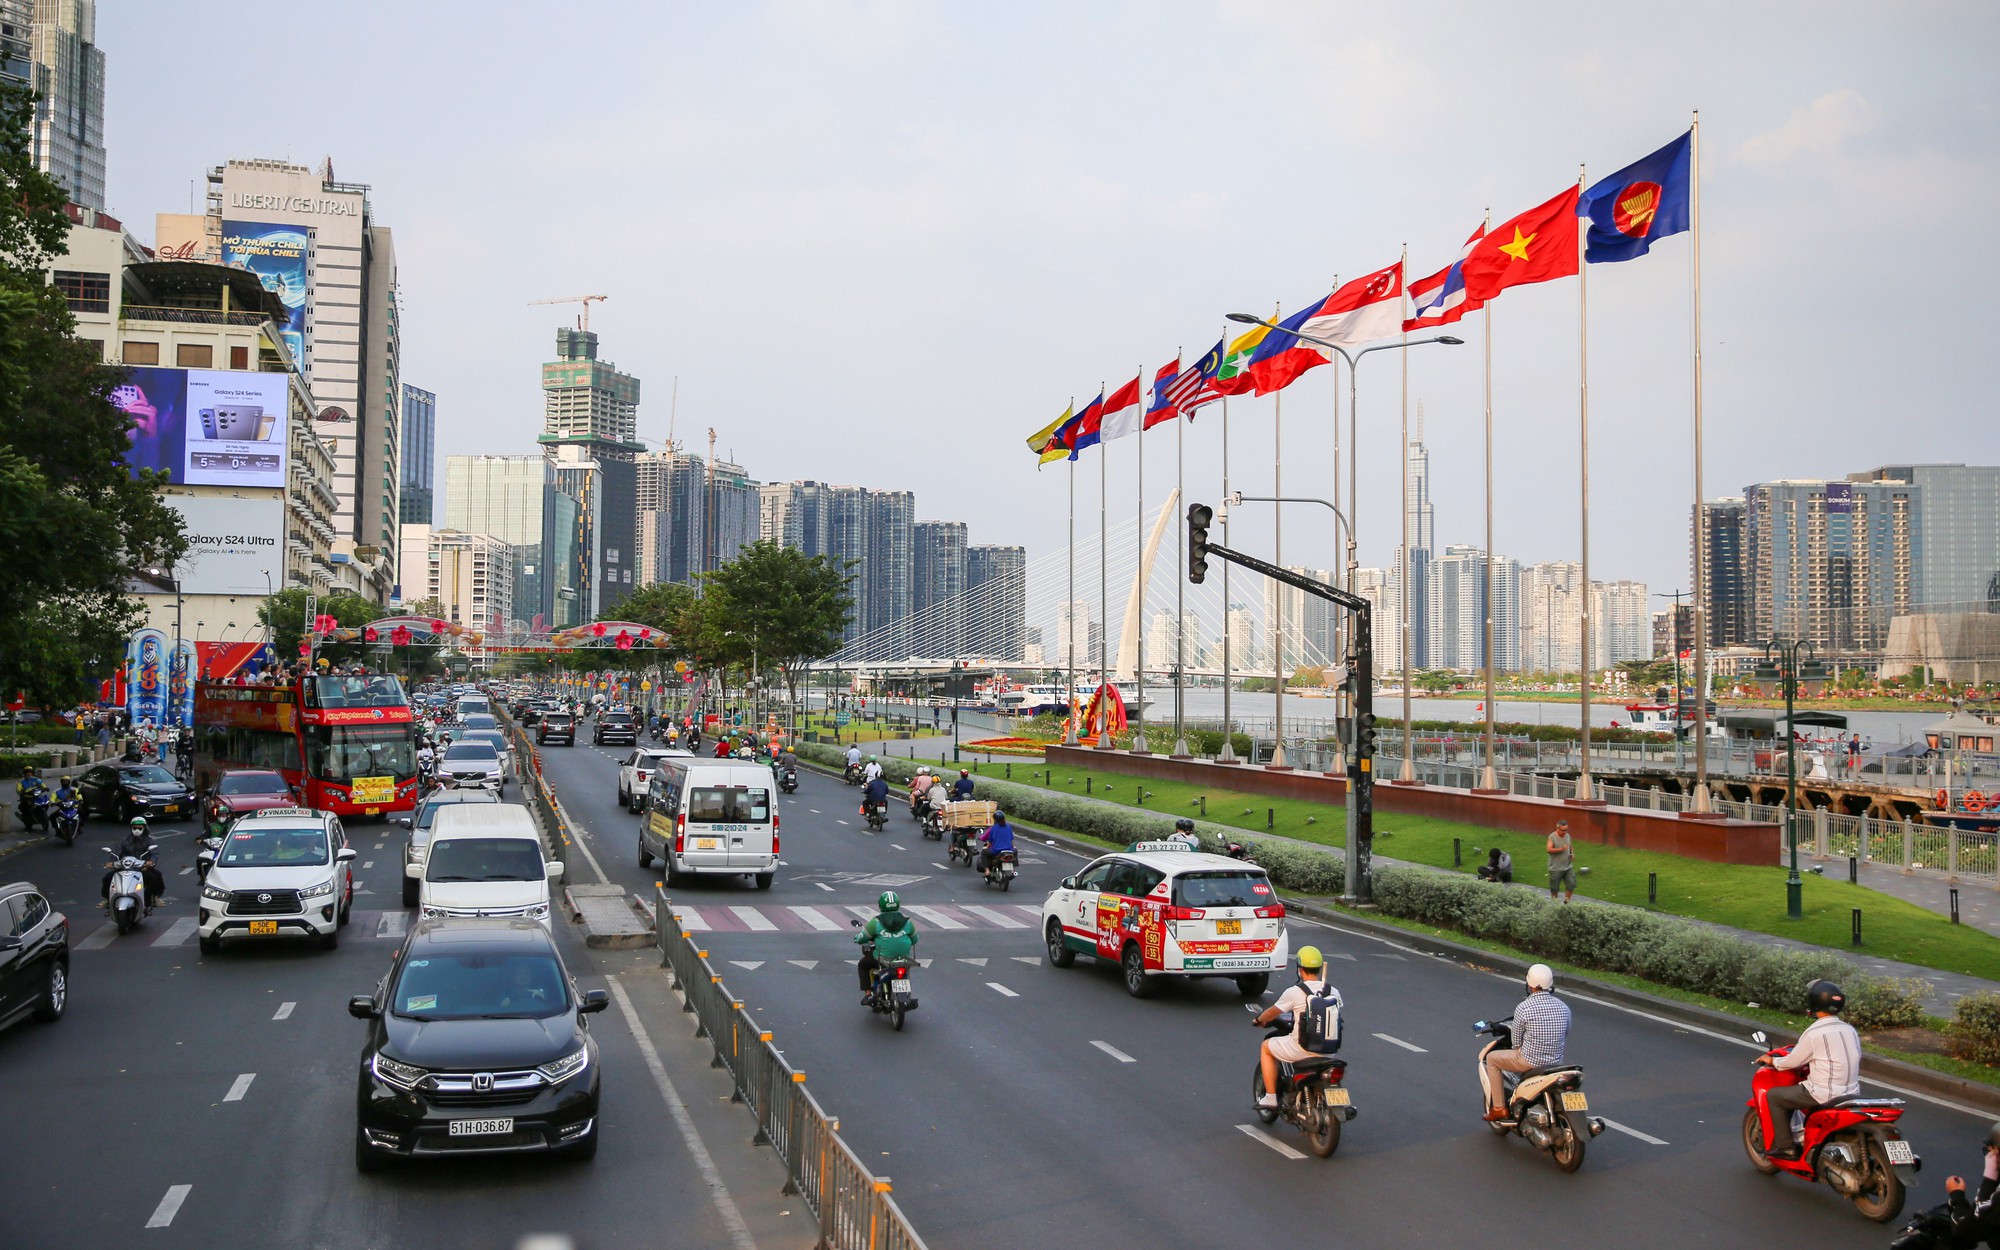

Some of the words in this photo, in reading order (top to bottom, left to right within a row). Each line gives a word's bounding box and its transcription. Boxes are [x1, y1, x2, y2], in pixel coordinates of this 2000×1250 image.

[231, 192, 291, 211] LIBERTY
[291, 198, 358, 217] CENTRAL
[277, 241, 304, 250] CHILL
[273, 248, 300, 258] CHILL
[200, 457, 208, 467] 5
[181, 533, 223, 546] Galaxy
[225, 535, 245, 545] S24
[247, 536, 275, 546] Ultra
[127, 664, 168, 690] Tige
[451, 1119, 512, 1134] 51H-036.87
